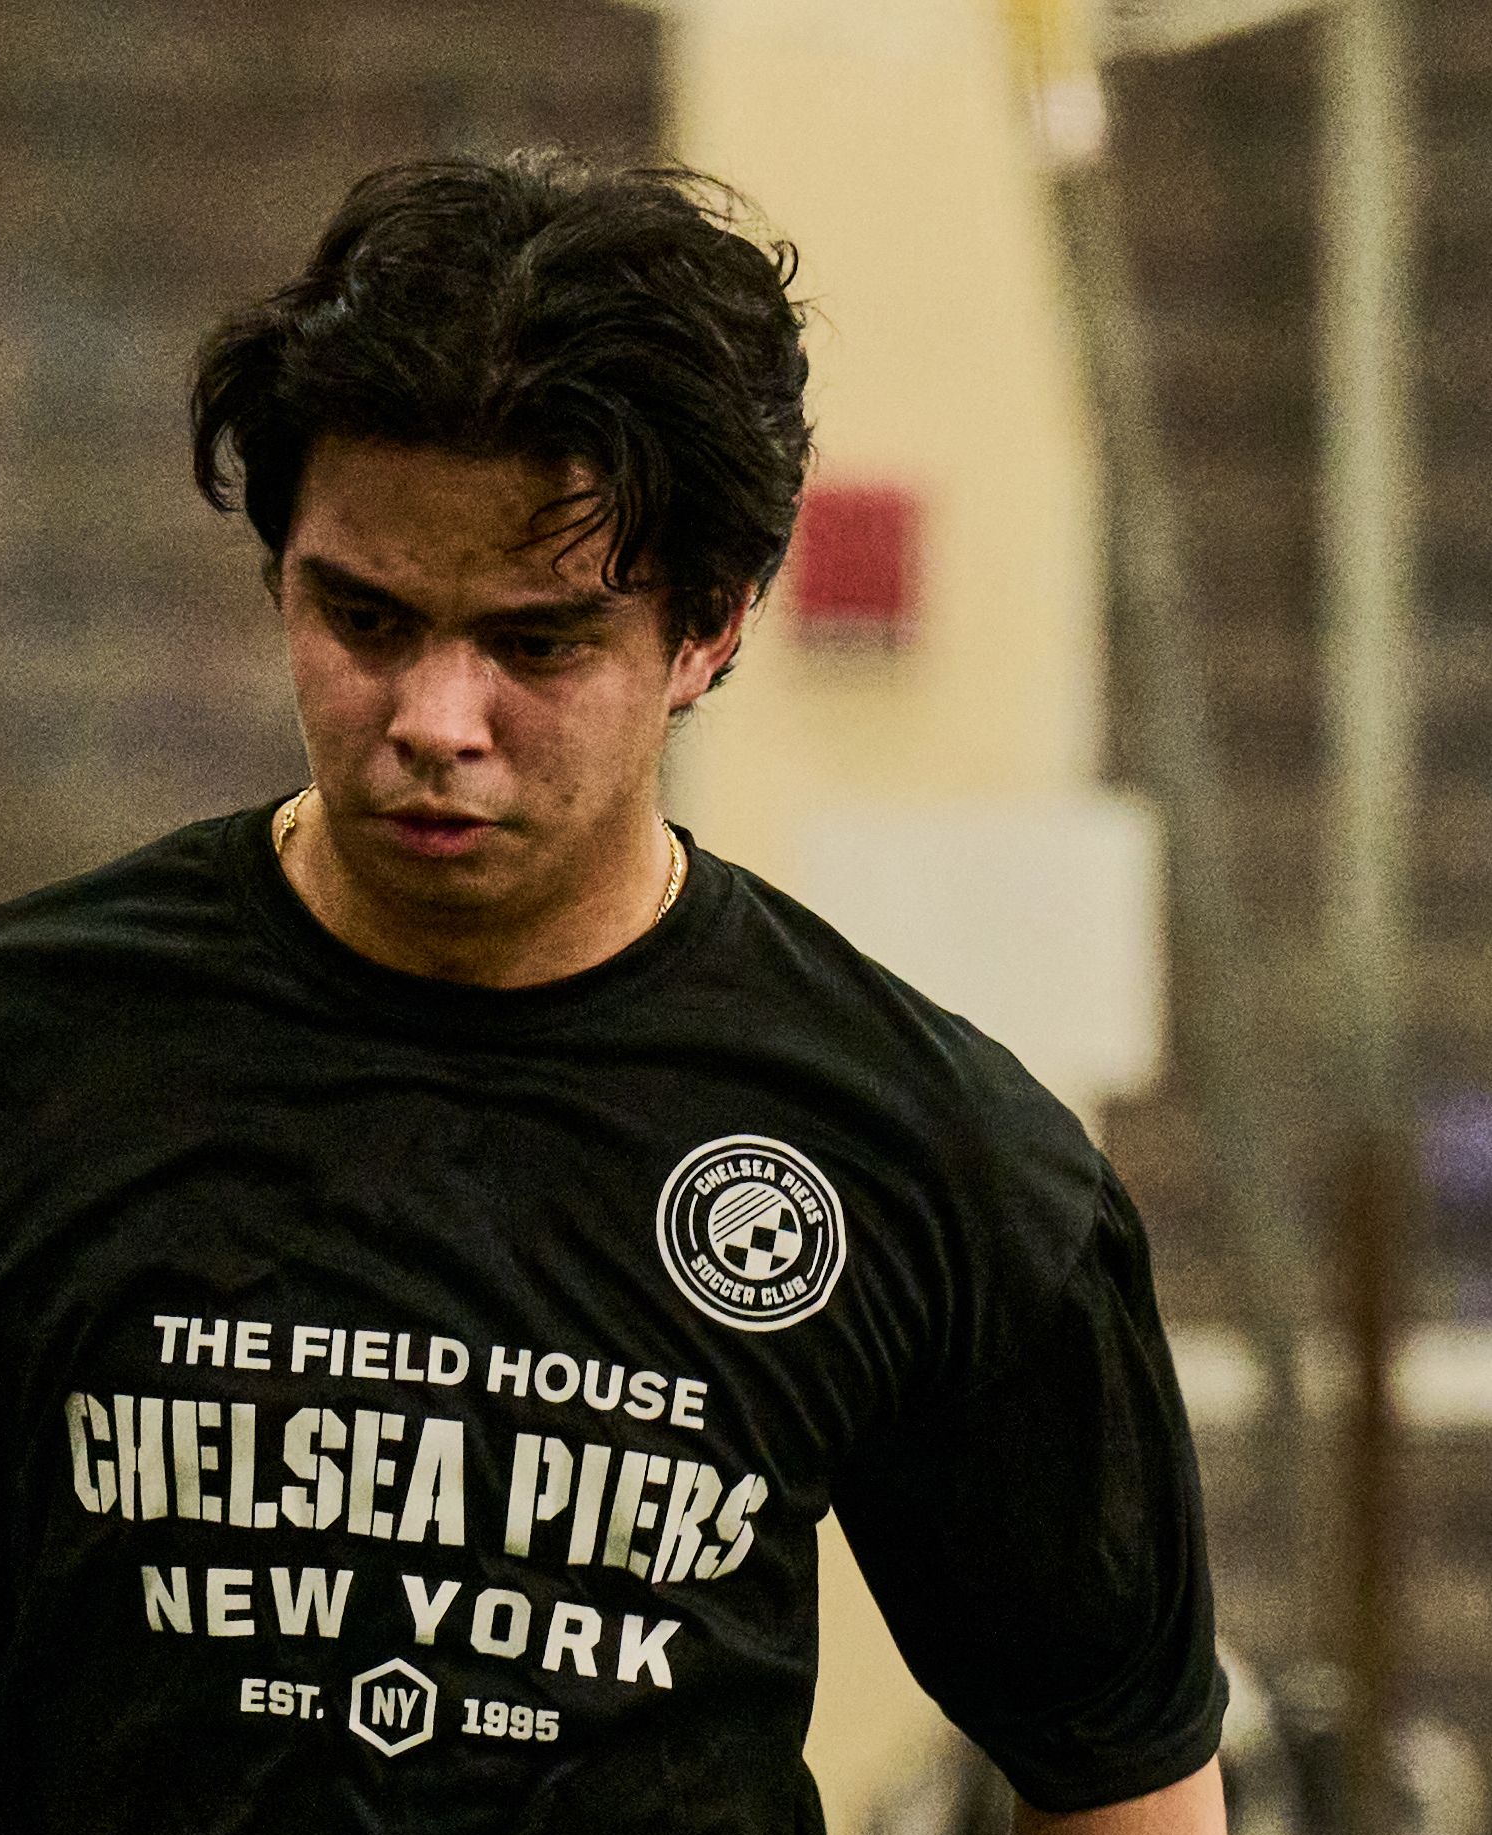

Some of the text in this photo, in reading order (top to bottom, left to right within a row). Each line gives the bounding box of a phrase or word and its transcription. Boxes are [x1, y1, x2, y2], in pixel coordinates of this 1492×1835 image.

[693, 1158, 823, 1226] CHELSEA PIERS
[690, 1253, 809, 1307] SOCCER CLUB
[153, 1314, 708, 1431] THE FIELD HOUSE
[65, 1391, 769, 1585] CHELSEA PIERS
[140, 1565, 683, 1690] NEW YORK
[239, 1678, 560, 1743] EST. NY 1995
